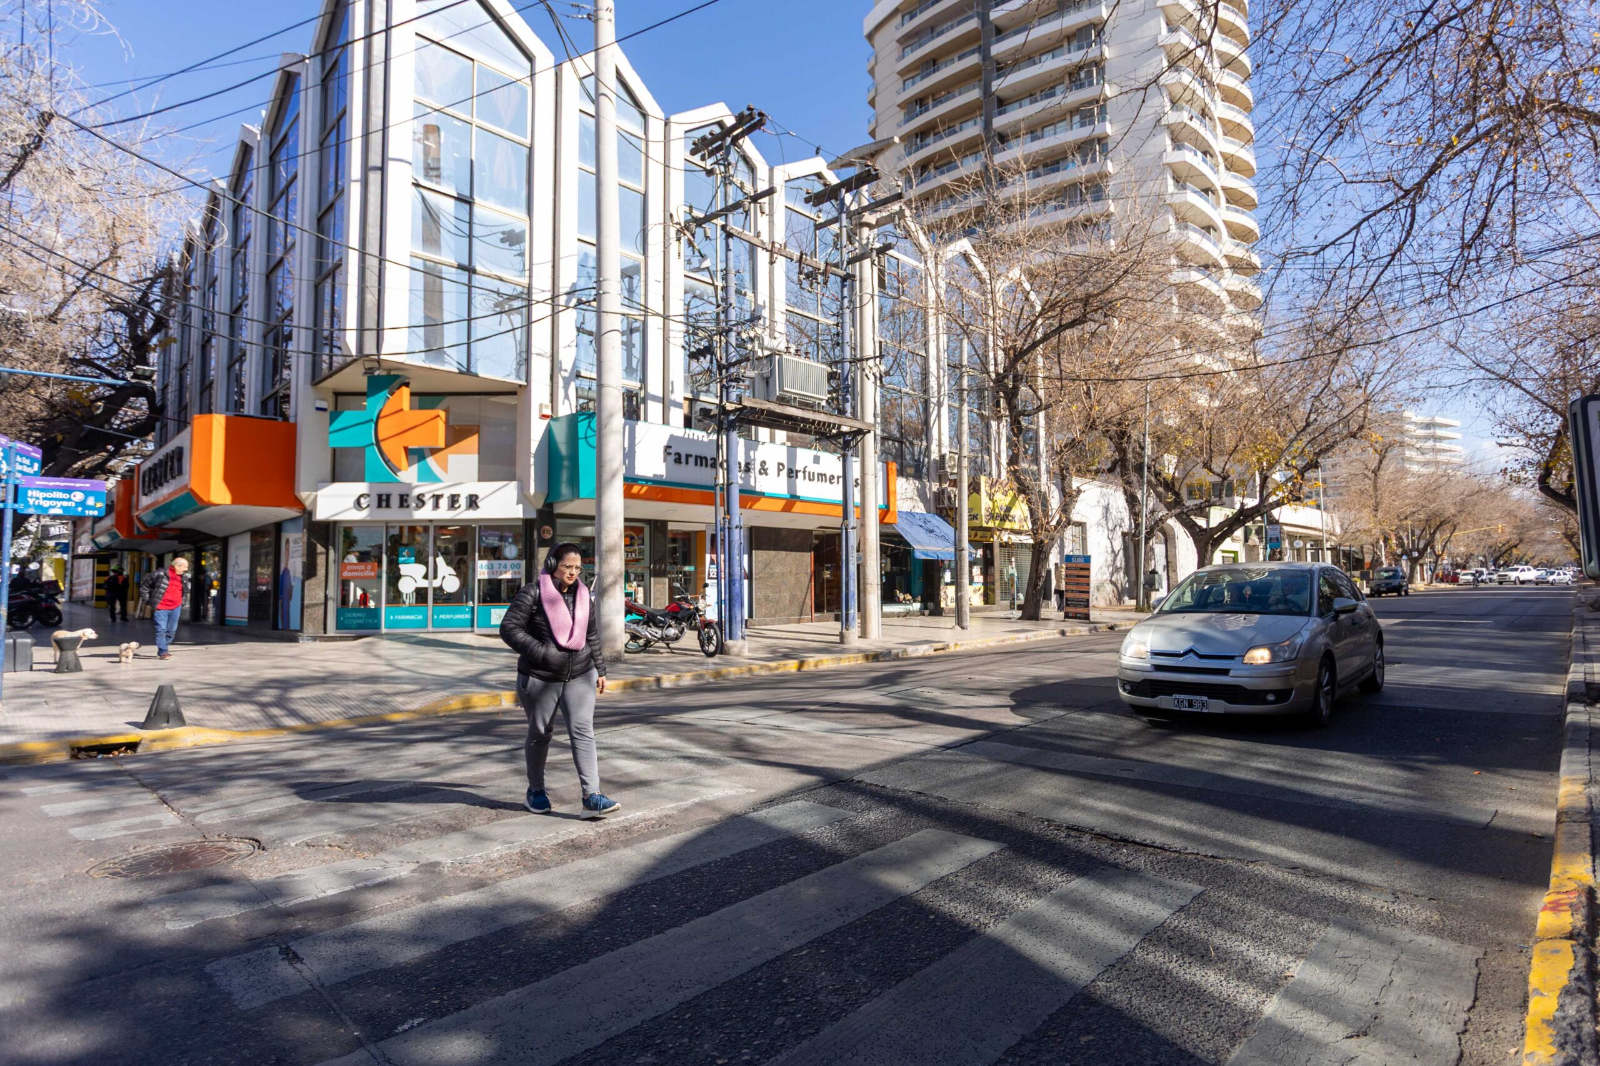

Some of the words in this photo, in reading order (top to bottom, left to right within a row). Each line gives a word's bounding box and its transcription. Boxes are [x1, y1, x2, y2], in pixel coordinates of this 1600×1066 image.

[758, 460, 769, 476] &
[777, 462, 861, 489] Perfumers
[27, 498, 76, 508] Yrigoyen
[356, 493, 480, 509] CHESTER
[479, 562, 494, 570] 463
[497, 562, 508, 570] 74
[510, 562, 521, 570] 00
[341, 569, 375, 577] domicilio
[1174, 699, 1188, 708] KGN
[1192, 700, 1207, 710] 983
